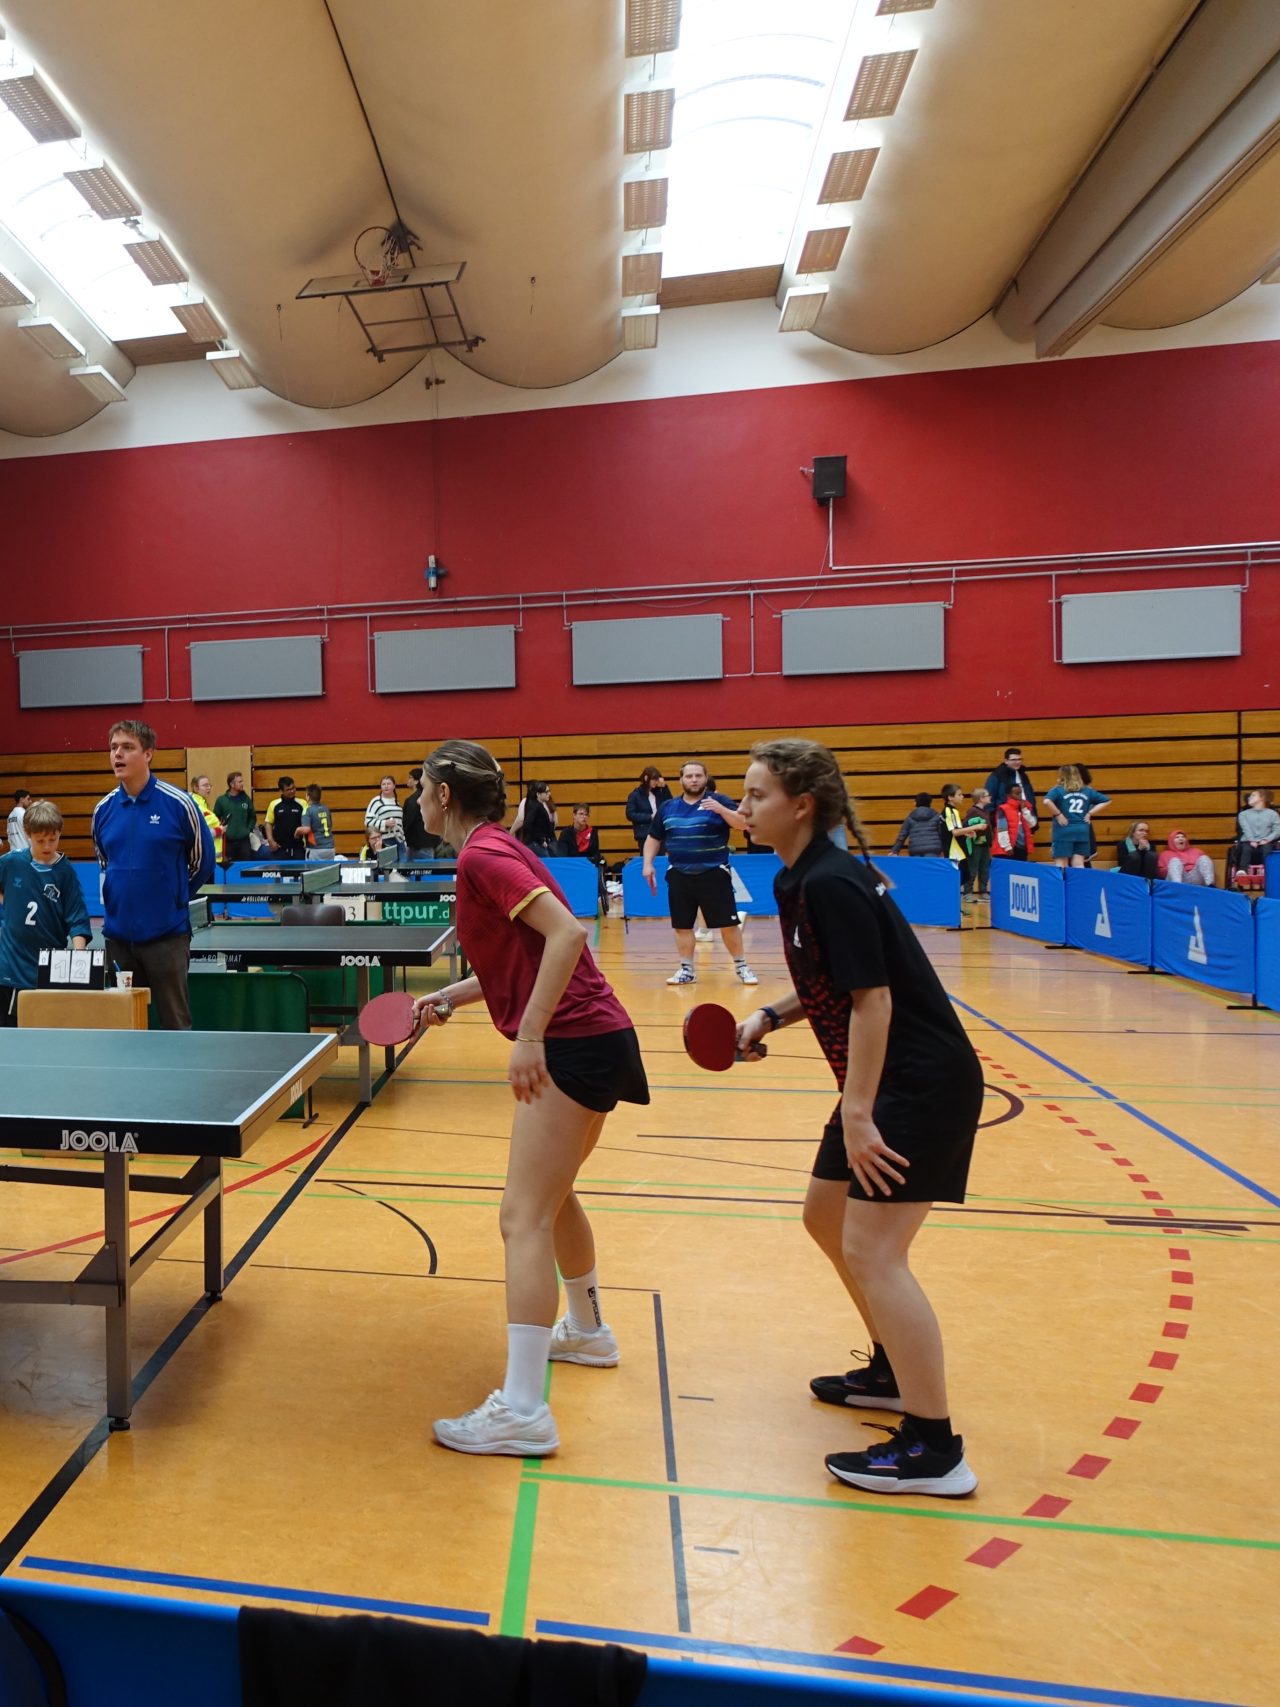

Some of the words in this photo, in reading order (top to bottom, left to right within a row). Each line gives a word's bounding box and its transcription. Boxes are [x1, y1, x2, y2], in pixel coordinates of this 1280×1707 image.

[1069, 798, 1084, 813] 22
[1011, 881, 1038, 915] JOOLA
[25, 901, 38, 926] 2
[340, 955, 381, 967] JOOLA
[60, 1129, 139, 1153] JOOLA
